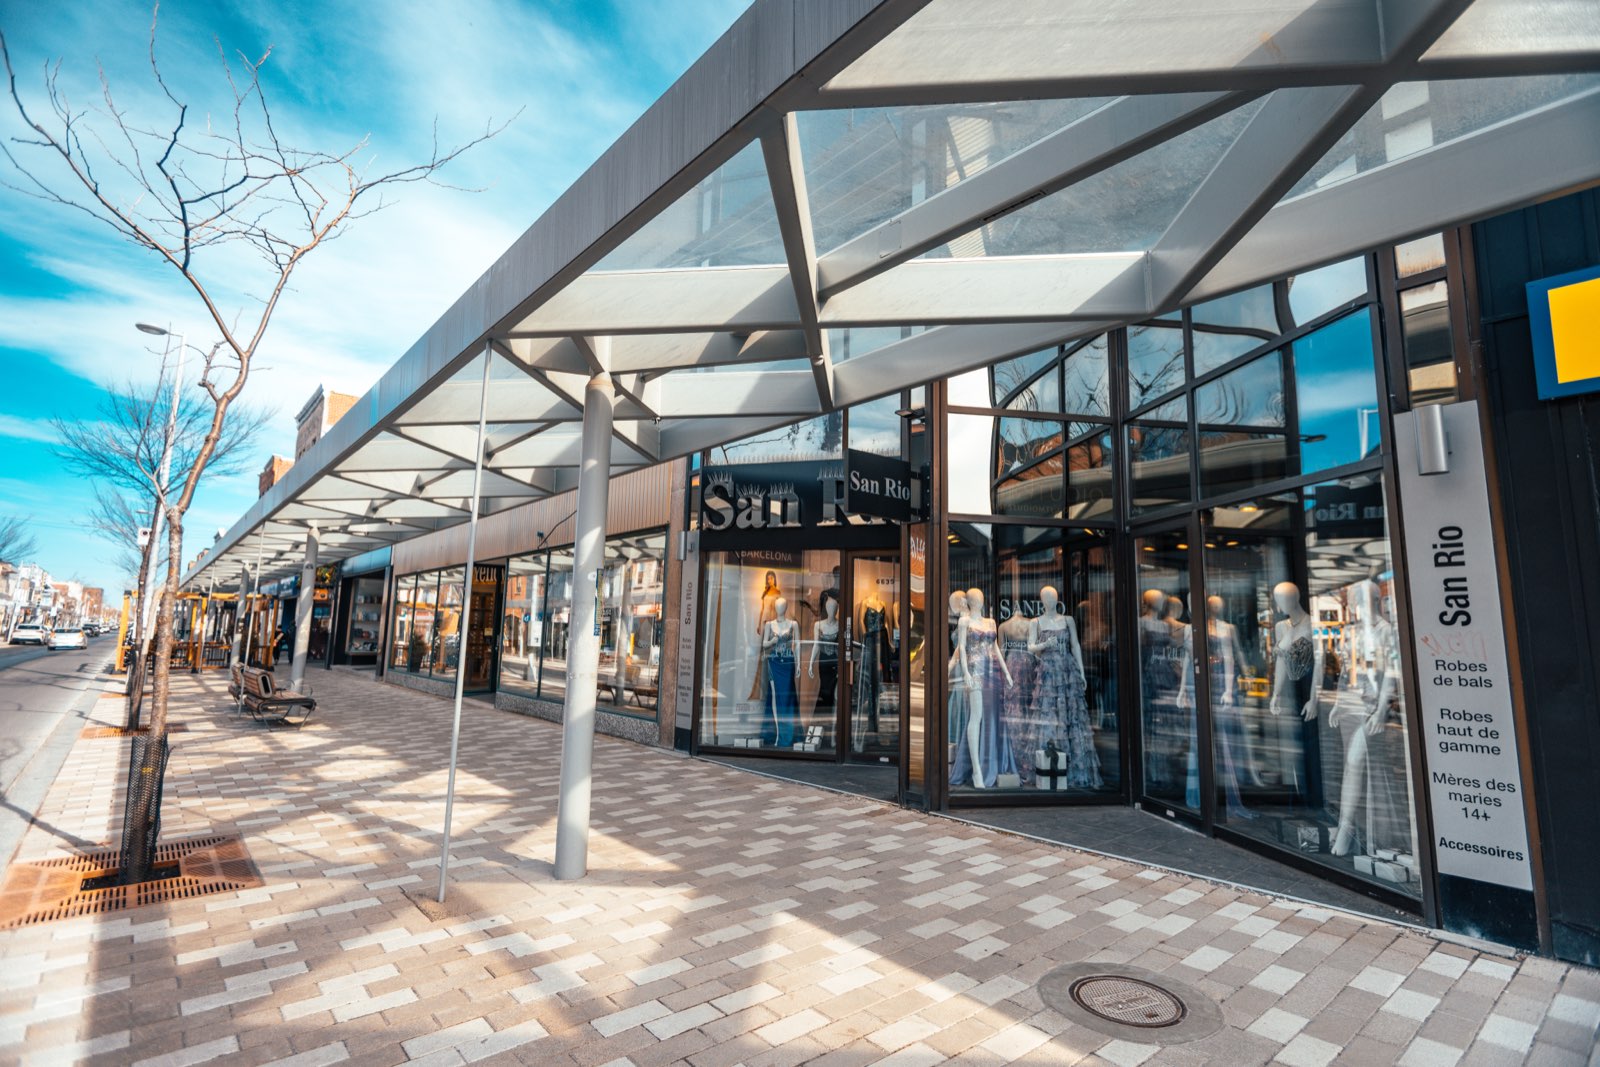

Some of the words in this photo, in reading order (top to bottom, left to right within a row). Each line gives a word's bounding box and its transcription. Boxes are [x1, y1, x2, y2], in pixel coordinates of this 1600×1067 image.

[850, 470, 880, 495] San
[884, 477, 911, 501] Rio
[703, 475, 802, 530] San
[1432, 525, 1466, 568] Rio
[1000, 599, 1066, 620] SANRO
[1438, 577, 1472, 627] San
[1435, 659, 1488, 672] Robes
[1433, 675, 1453, 687] de
[1458, 675, 1493, 688] bals
[1440, 708, 1494, 723] Robes
[1437, 723, 1473, 737] haut
[1478, 726, 1500, 739] de
[1439, 741, 1501, 755] gamme
[1433, 772, 1481, 788] Mères
[1486, 778, 1516, 793] des
[1448, 791, 1502, 807] maries
[1461, 807, 1491, 821] 14+
[1439, 836, 1524, 861] Accessoires
